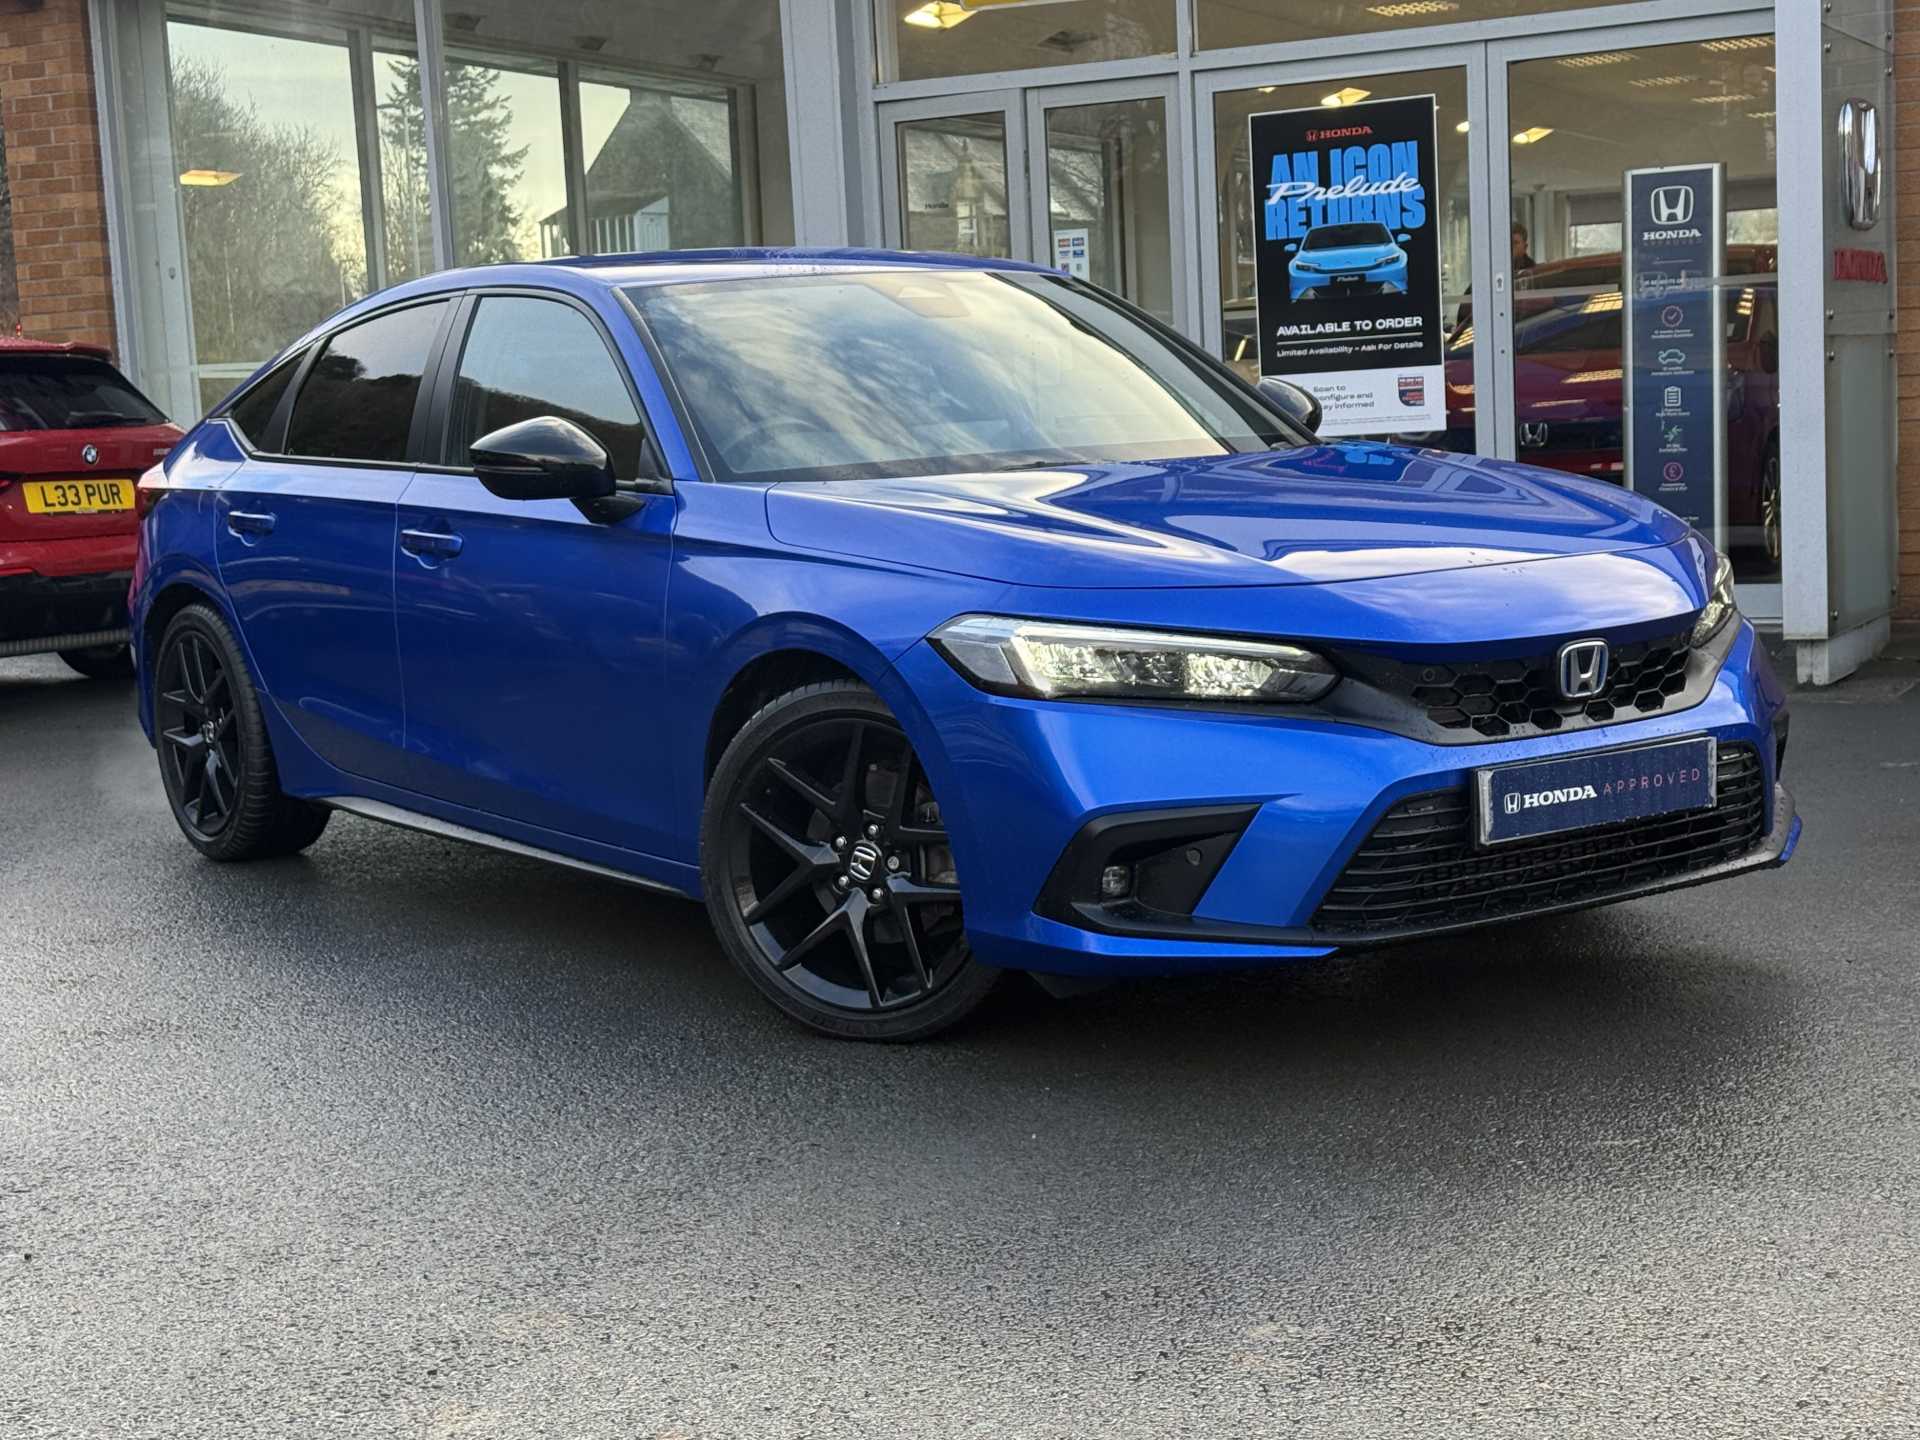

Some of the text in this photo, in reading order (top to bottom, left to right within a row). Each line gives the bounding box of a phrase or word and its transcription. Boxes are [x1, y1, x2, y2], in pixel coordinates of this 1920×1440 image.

[1319, 126, 1373, 140] HONDA
[1270, 140, 1419, 200] AN ICON
[1265, 172, 1421, 206] Prelude
[1265, 186, 1426, 240] RETURNS
[1642, 229, 1702, 240] HONDA
[1276, 316, 1423, 337] AVAILABLE TO ORDER
[1276, 348, 1308, 358] Limited
[1309, 345, 1354, 355] Availability
[1361, 344, 1377, 352] Ask
[1393, 340, 1424, 350] Details
[1334, 400, 1375, 409] informed
[40, 483, 123, 507] L33 PUR
[1523, 768, 1701, 809] HONDA APPROVED
